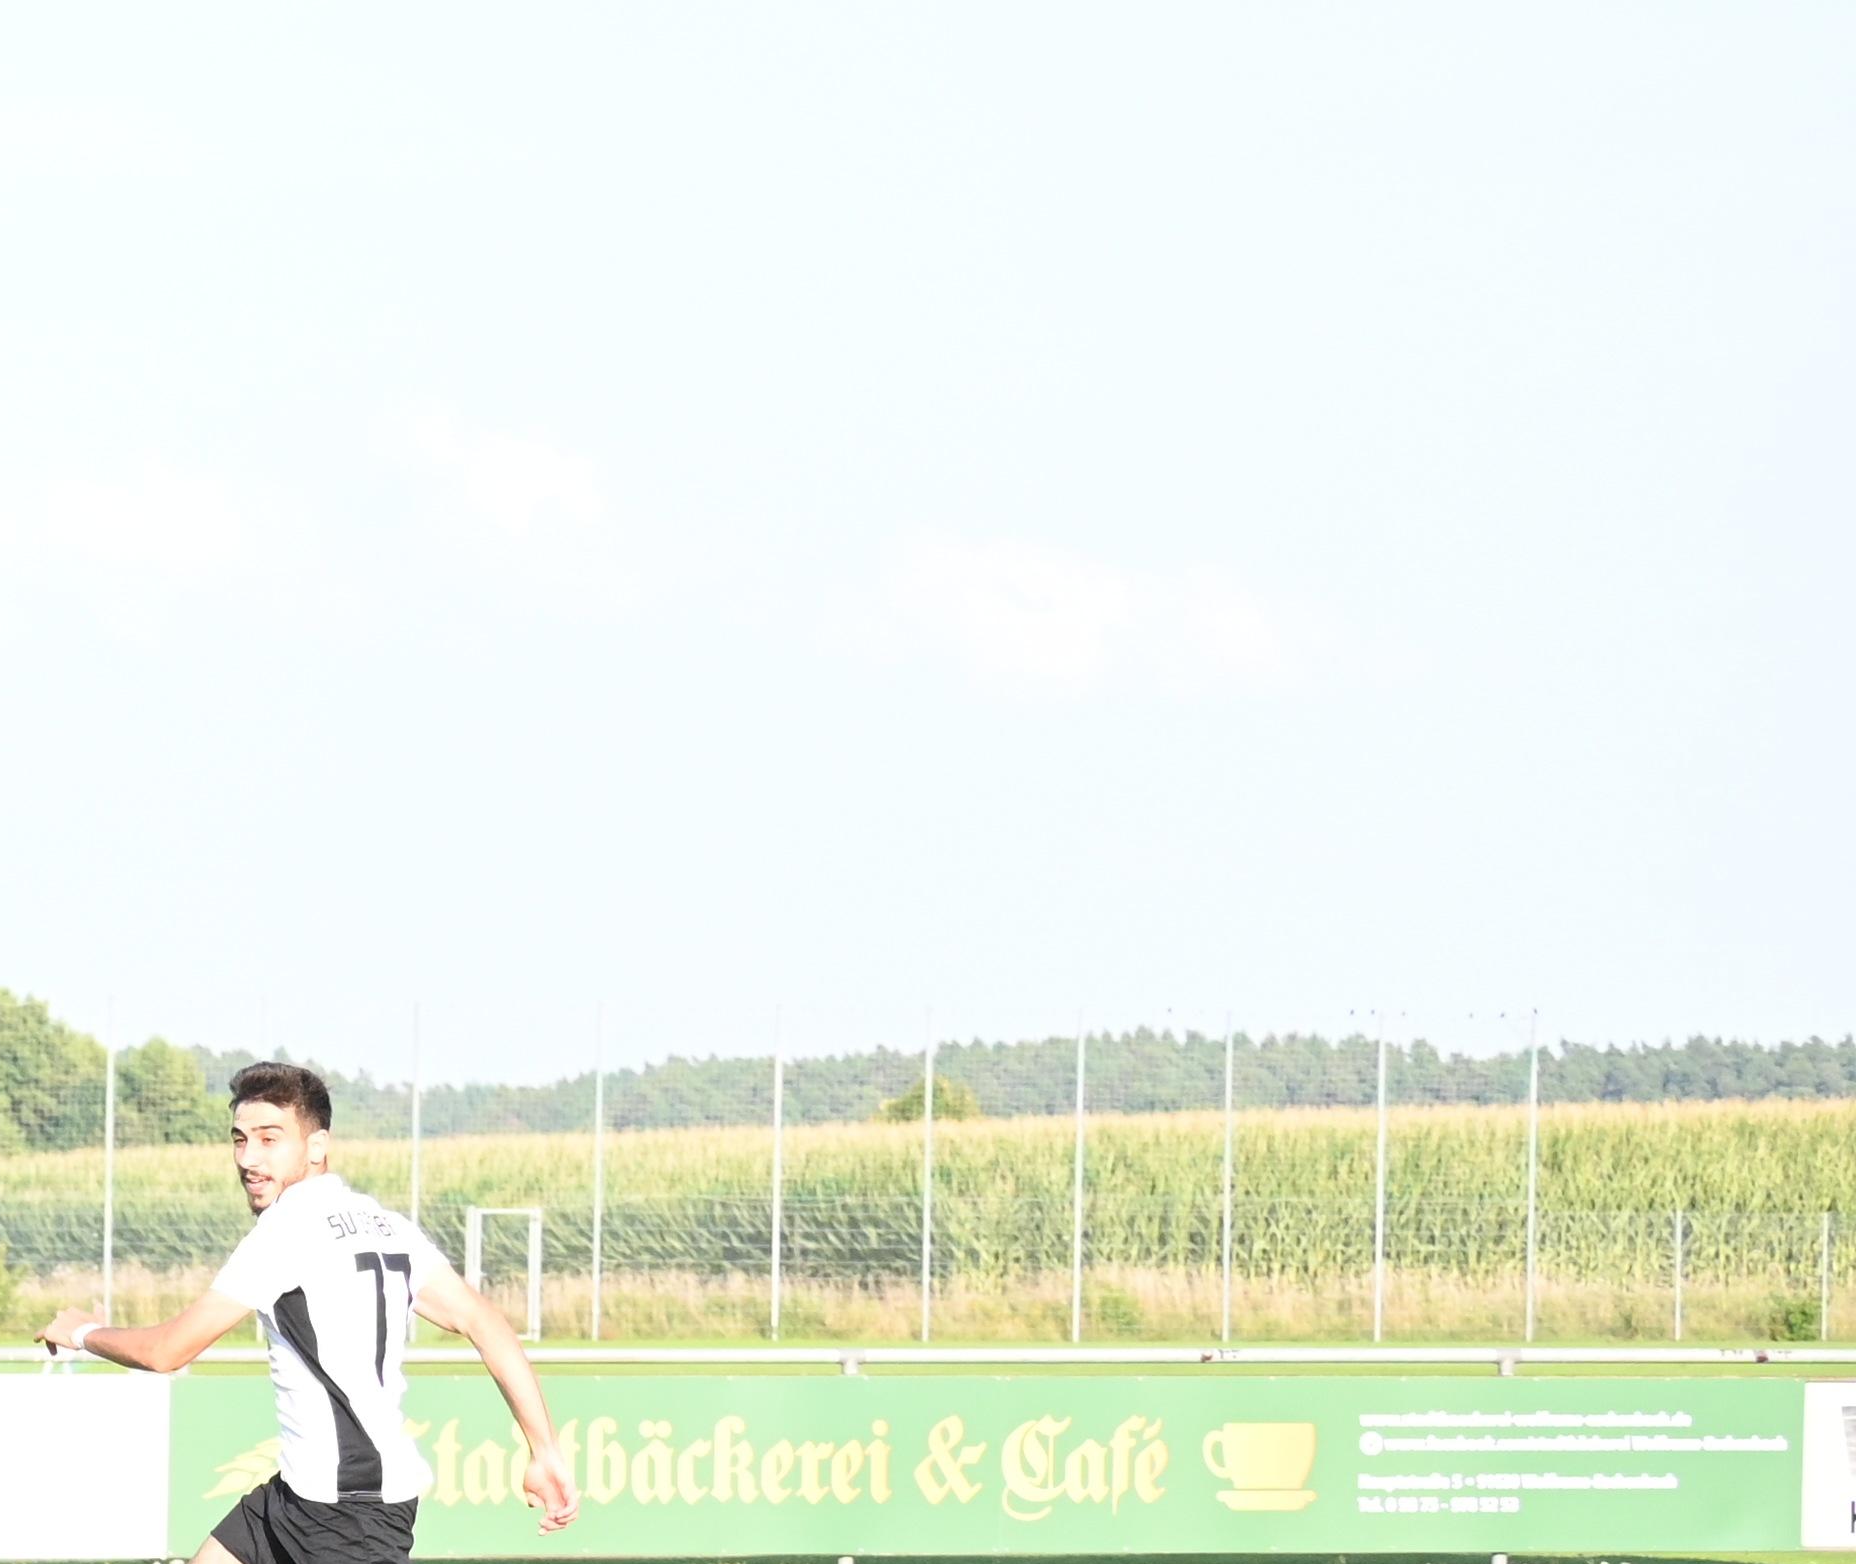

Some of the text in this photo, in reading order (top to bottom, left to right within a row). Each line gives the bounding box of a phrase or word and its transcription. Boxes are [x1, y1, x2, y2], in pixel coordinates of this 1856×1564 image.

[355, 1252, 414, 1389] 77
[913, 1415, 988, 1505] &
[1000, 1414, 1171, 1522] Café
